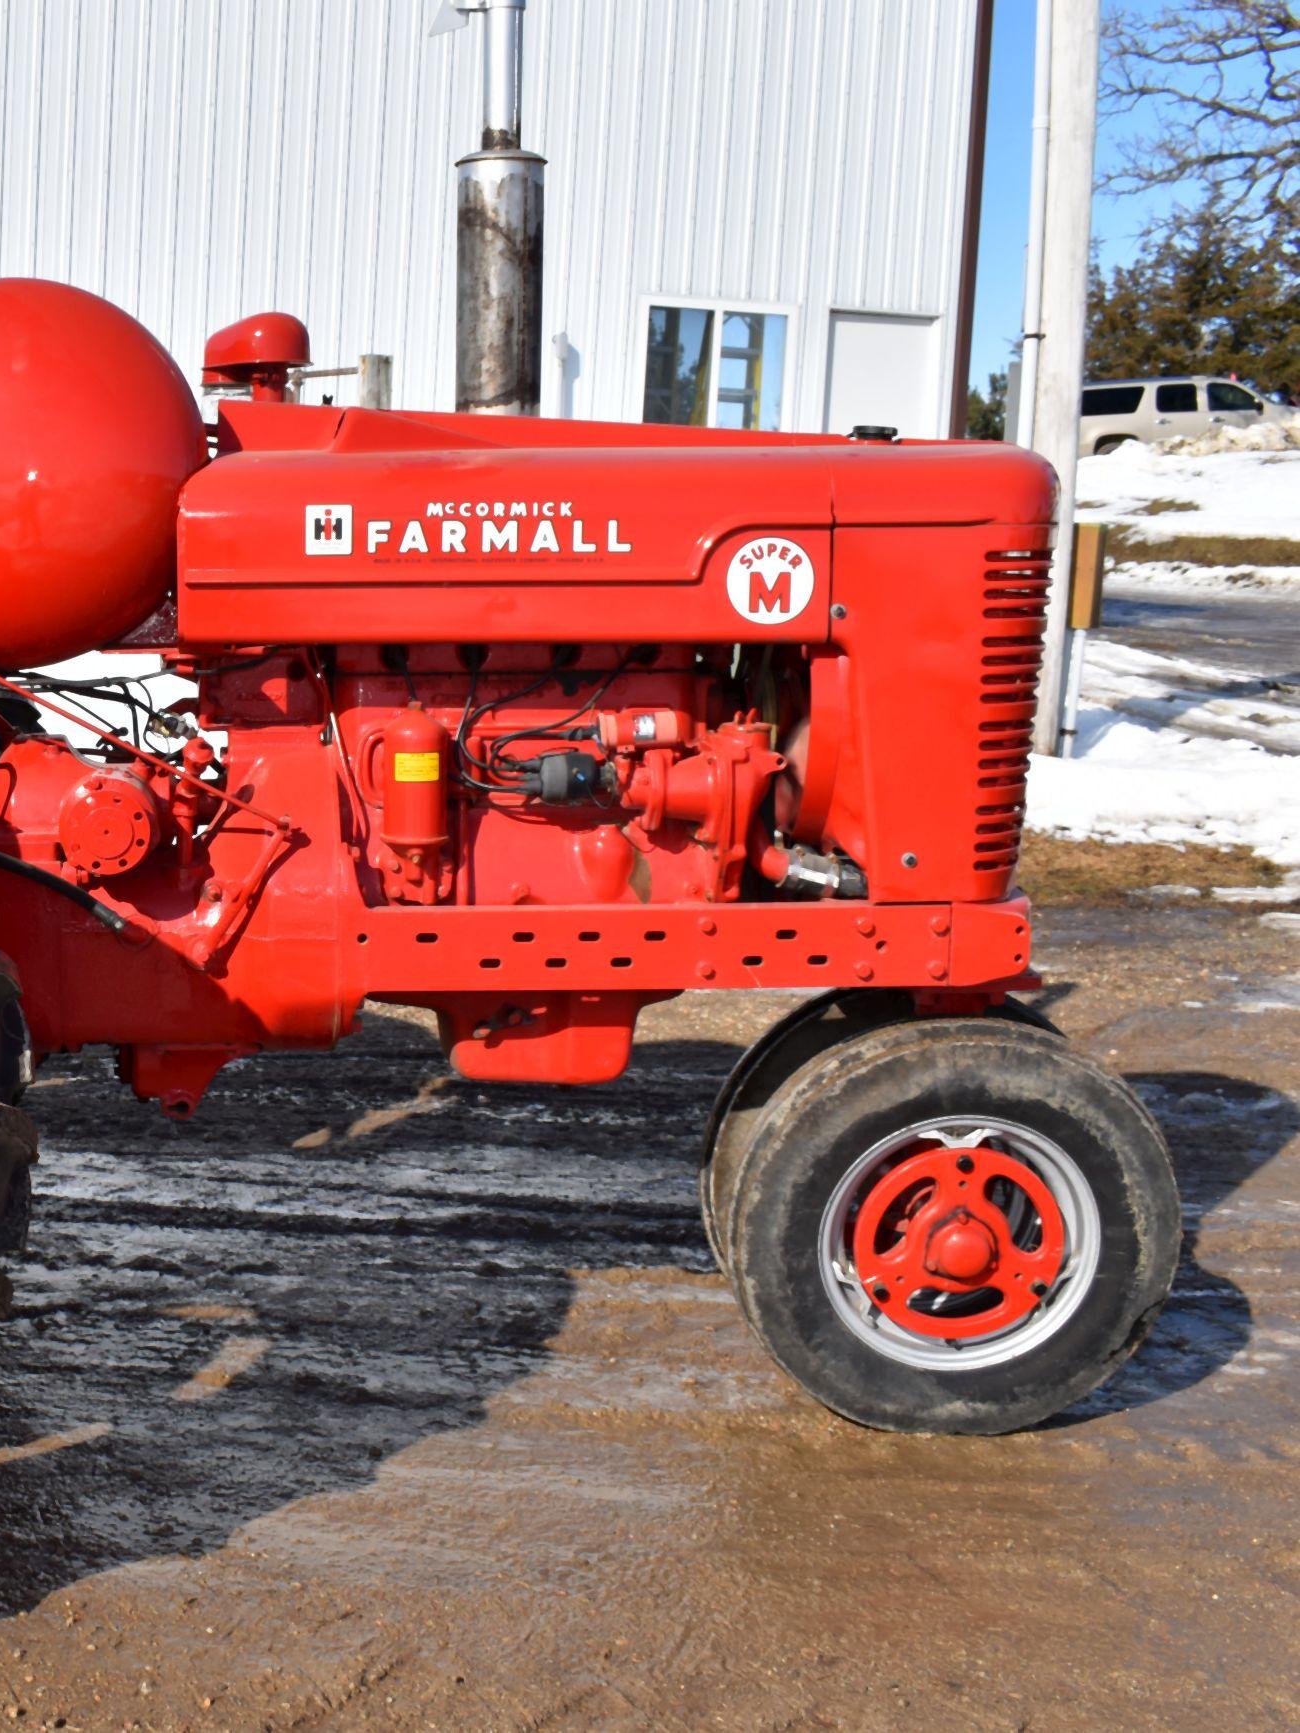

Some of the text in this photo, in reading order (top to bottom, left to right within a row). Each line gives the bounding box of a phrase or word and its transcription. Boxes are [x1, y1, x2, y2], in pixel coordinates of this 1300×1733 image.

[367, 519, 632, 553] FARMALL
[739, 543, 803, 569] SUPER
[748, 571, 791, 613] M
